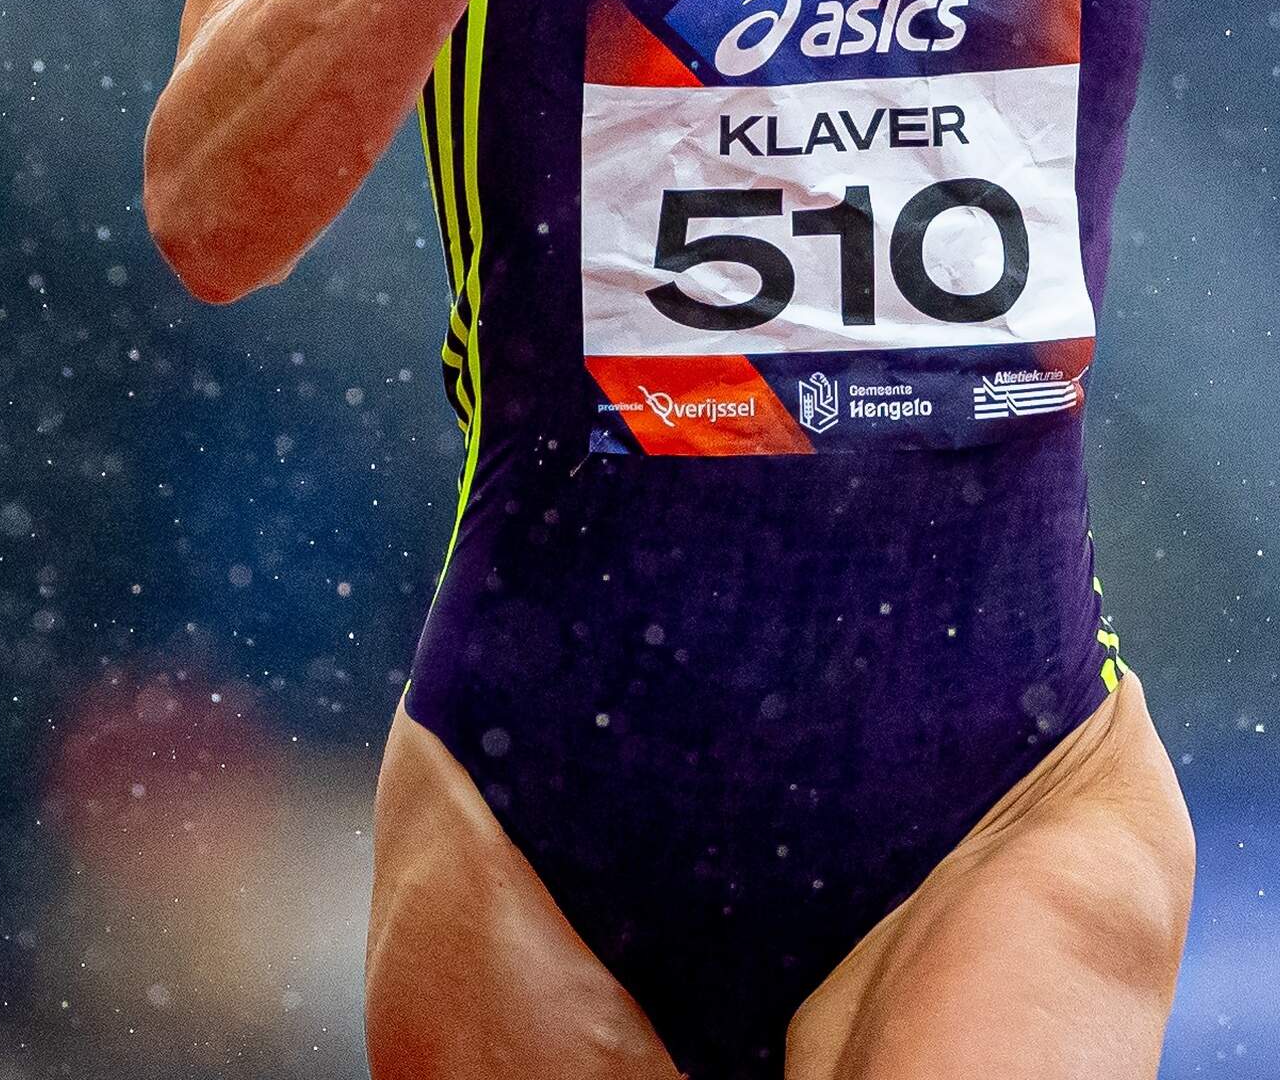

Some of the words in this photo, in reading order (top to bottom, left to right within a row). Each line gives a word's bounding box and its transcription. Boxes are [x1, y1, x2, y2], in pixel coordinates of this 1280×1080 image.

[719, 104, 970, 157] KLAVER
[644, 177, 1030, 332] 510
[994, 369, 1064, 385] Atletiekunie
[849, 384, 913, 397] Gemeente
[597, 402, 644, 413] provincie
[849, 398, 933, 421] Hengelo
